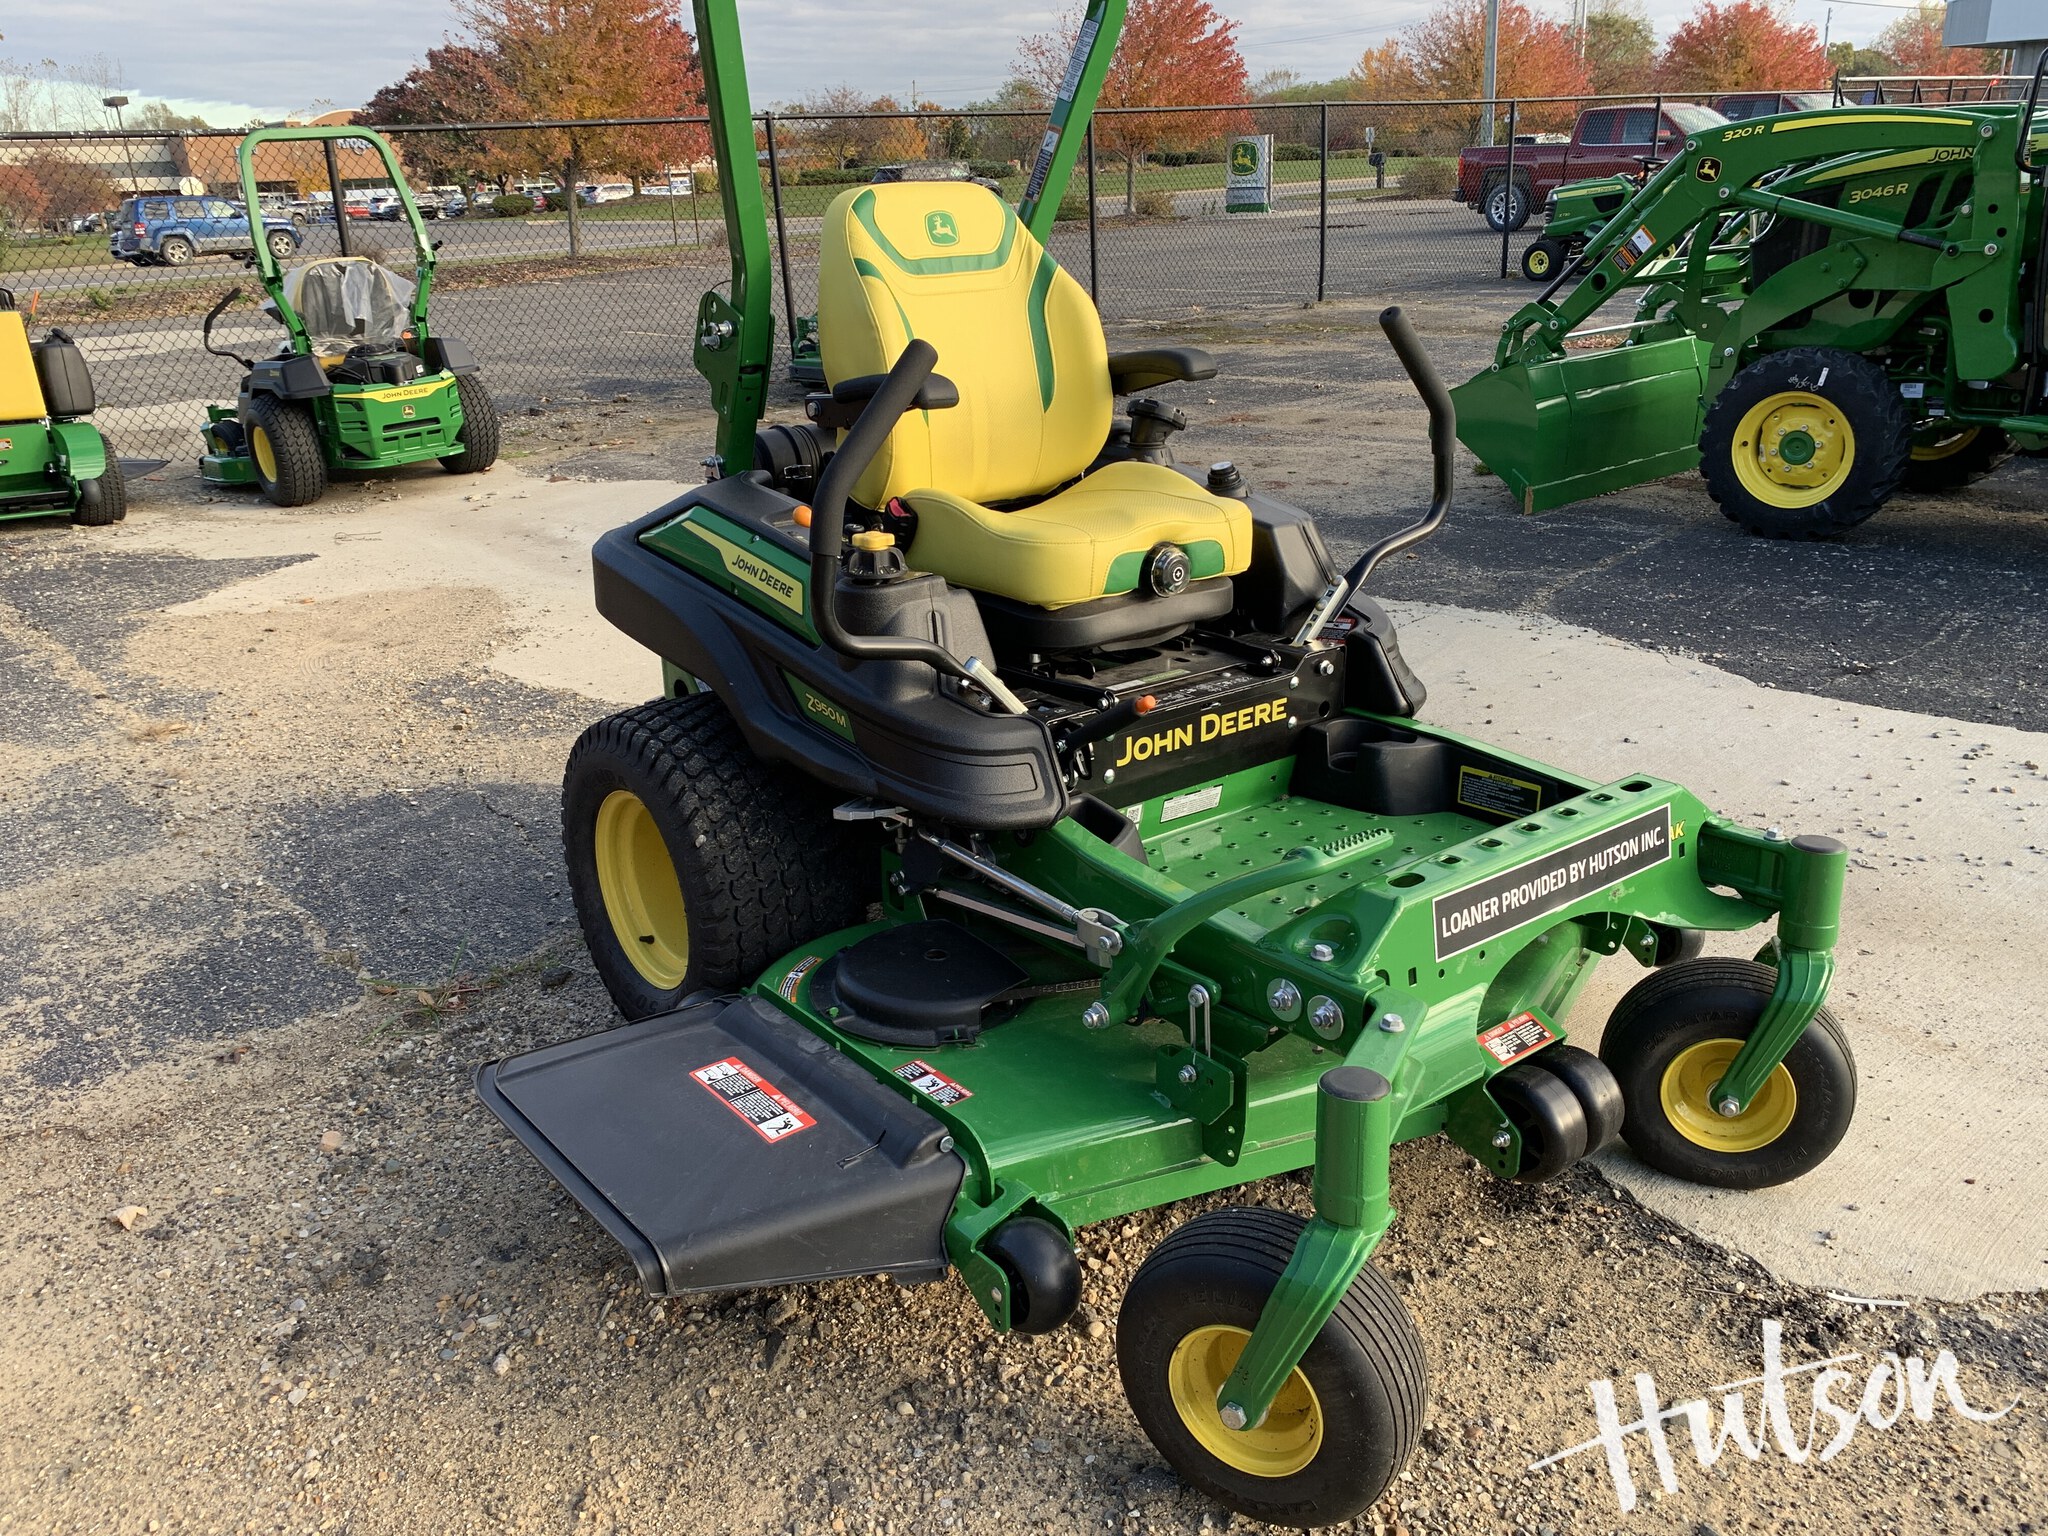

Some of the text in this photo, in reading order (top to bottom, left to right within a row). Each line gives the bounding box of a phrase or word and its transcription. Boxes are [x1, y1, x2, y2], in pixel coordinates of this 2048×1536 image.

[1721, 127, 1752, 142] 320
[1927, 147, 1974, 162] JOHN
[403, 387, 428, 396] DEERE
[731, 554, 794, 599] JOHN DEERE
[1116, 697, 1288, 767] JOHN DEERE
[1441, 826, 1665, 938] LOANER PROVIDED BY HUTSON INC.
